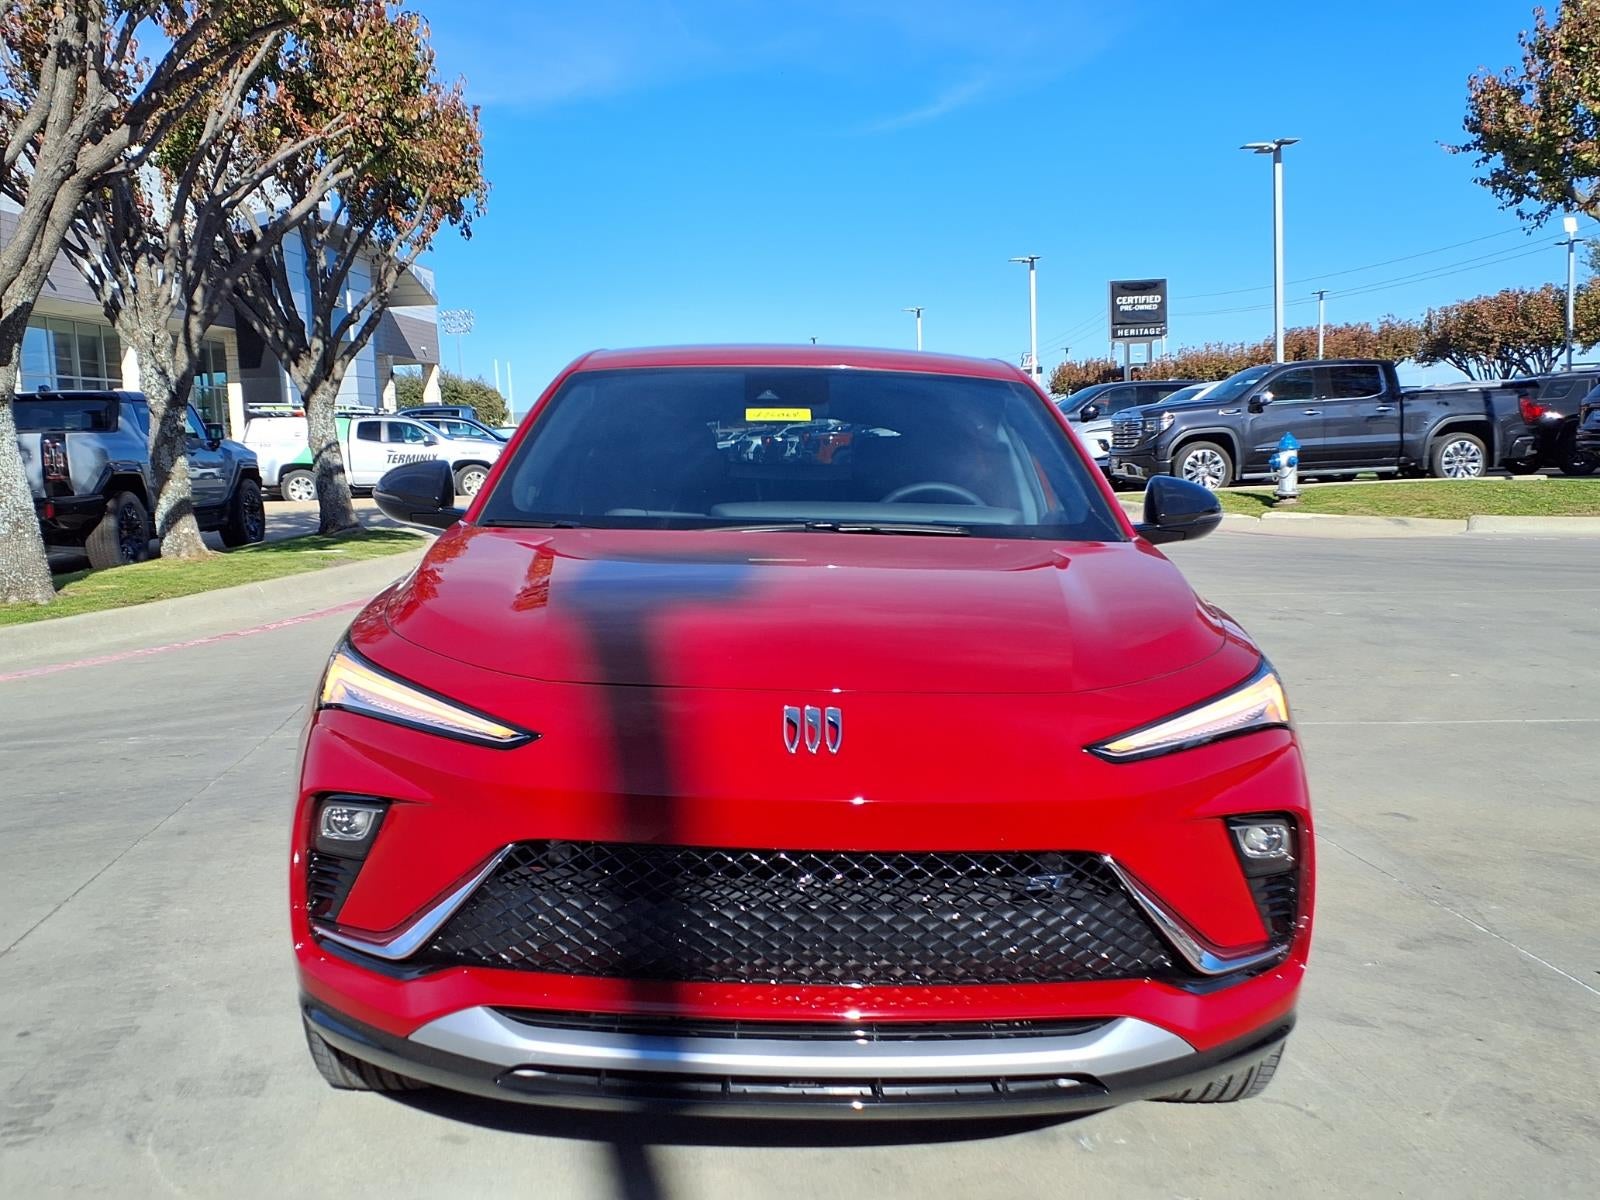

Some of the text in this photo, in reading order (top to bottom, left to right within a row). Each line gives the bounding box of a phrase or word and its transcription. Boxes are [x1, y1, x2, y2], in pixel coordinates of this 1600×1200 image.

[1116, 295, 1162, 305] CERTIFIED
[1117, 327, 1162, 337] HERITAGE
[386, 453, 438, 464] TERMINIX
